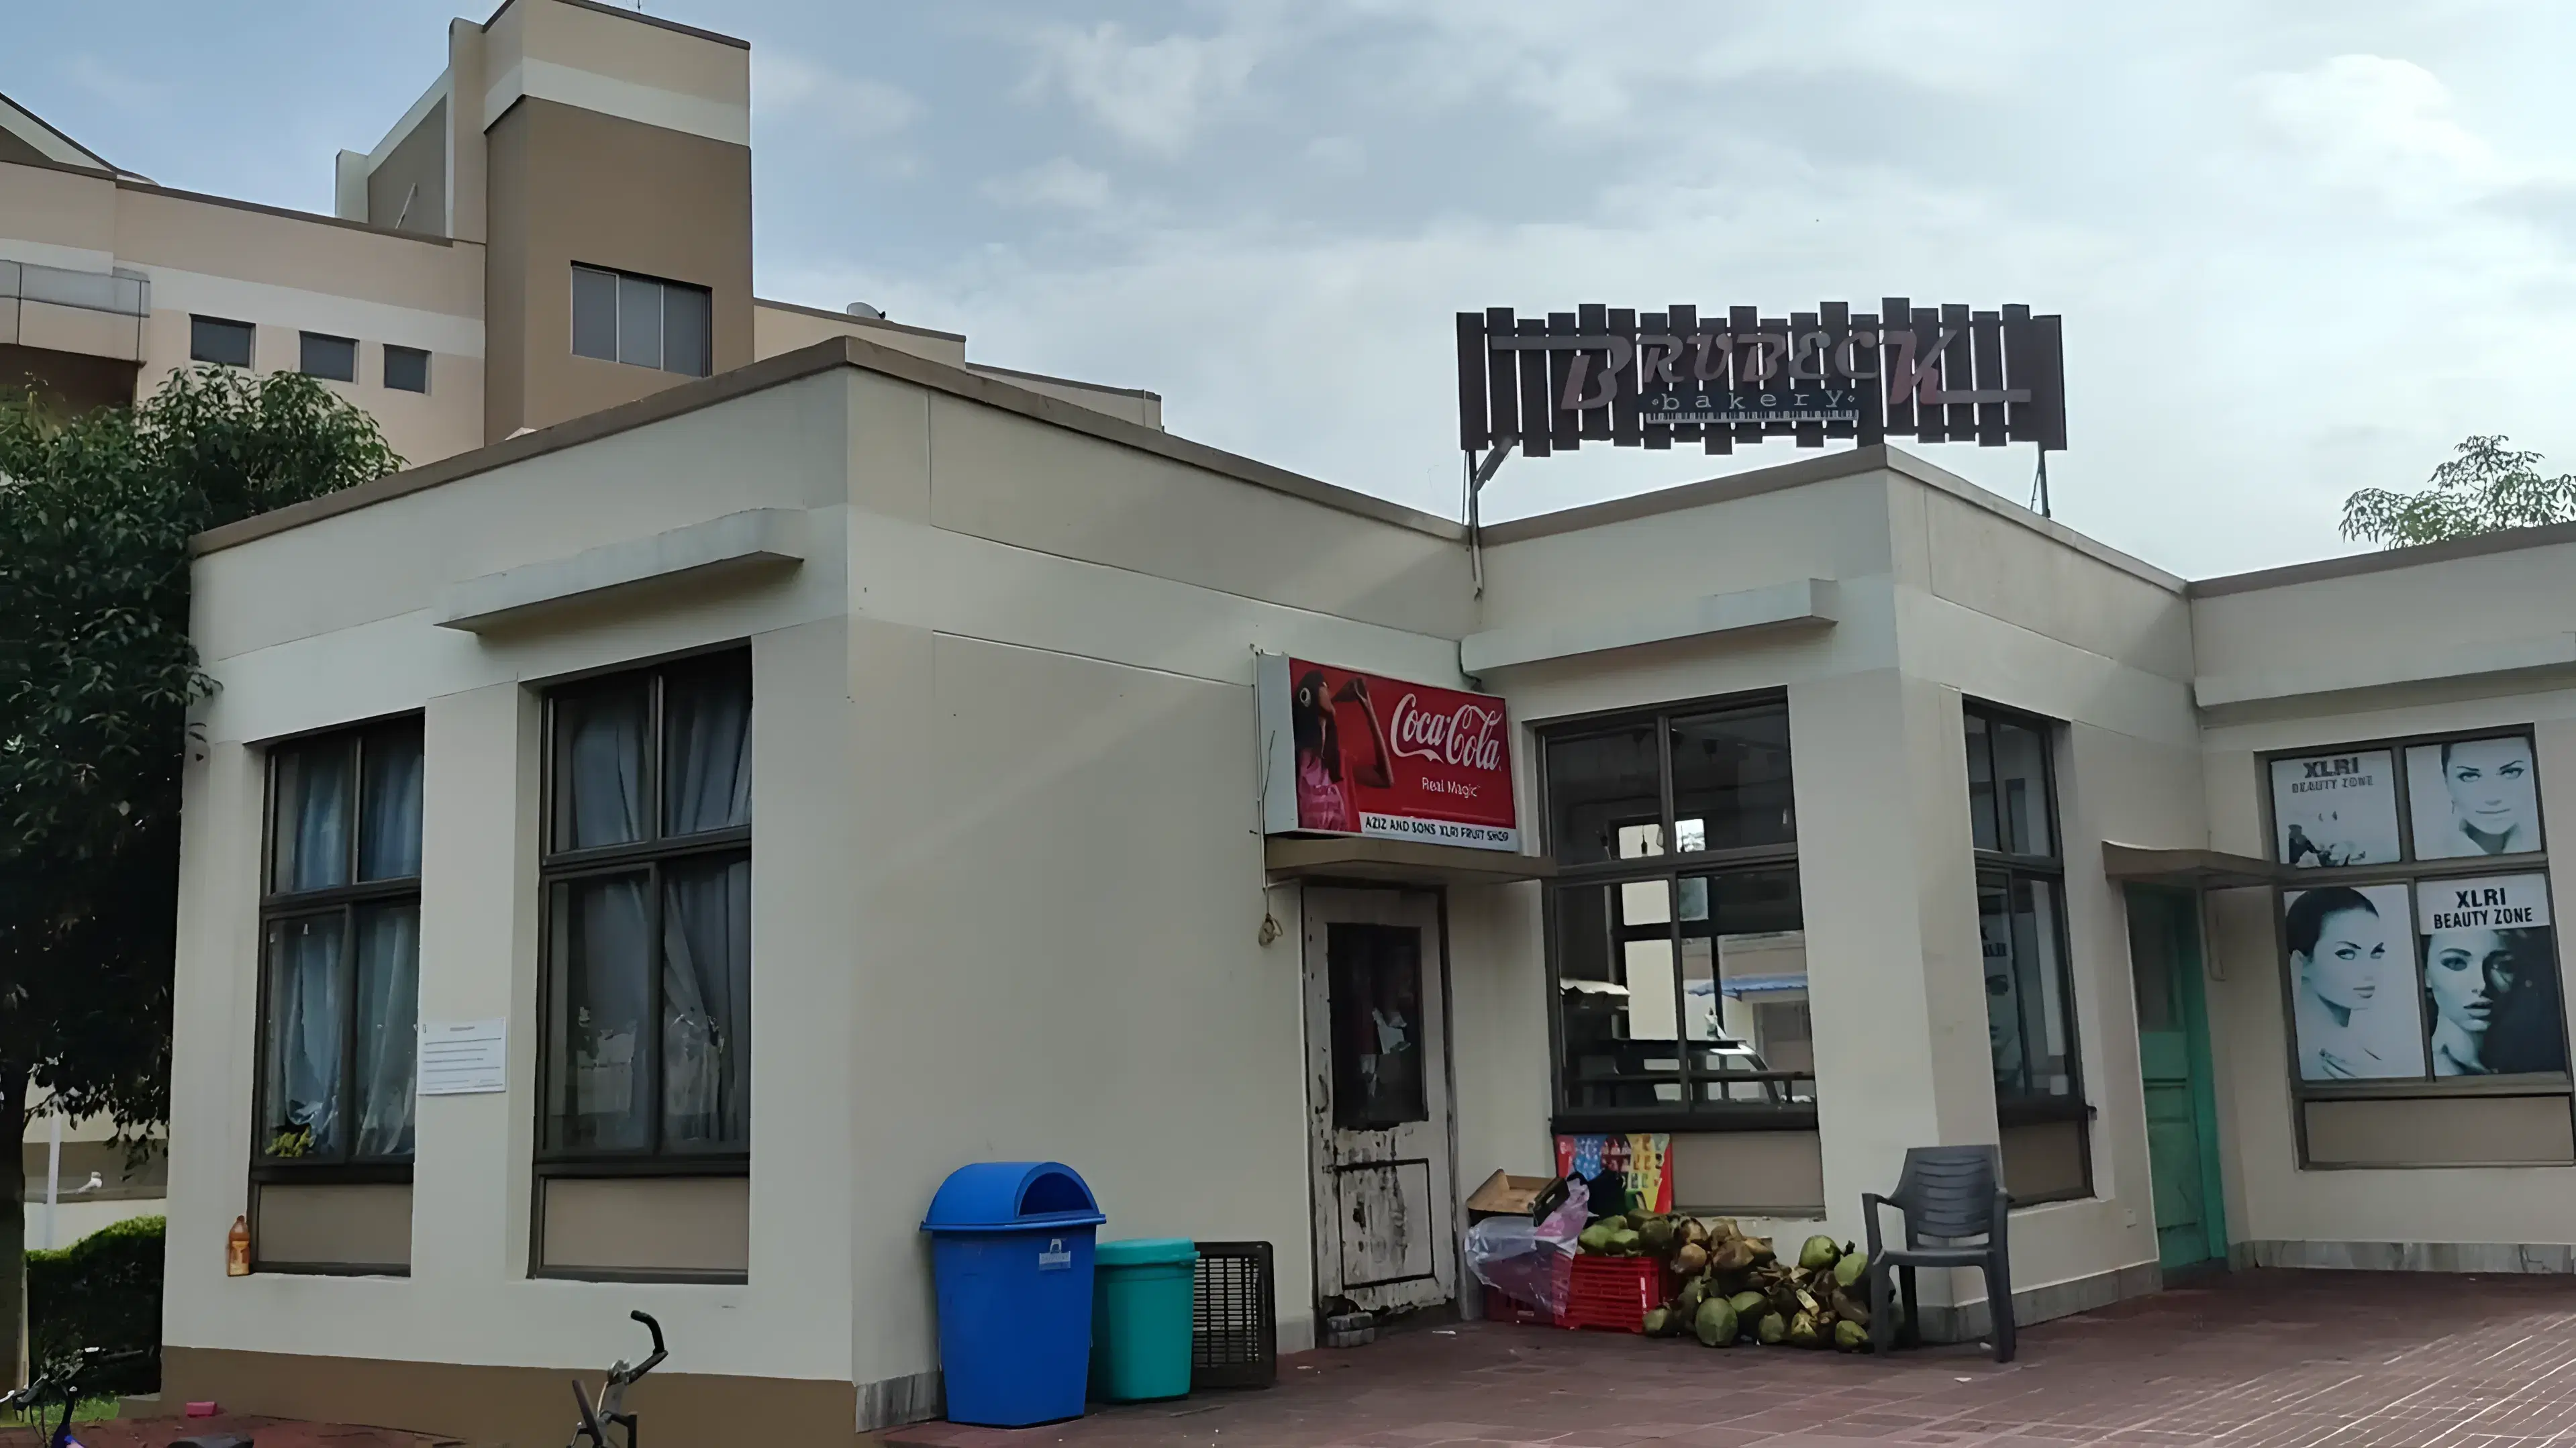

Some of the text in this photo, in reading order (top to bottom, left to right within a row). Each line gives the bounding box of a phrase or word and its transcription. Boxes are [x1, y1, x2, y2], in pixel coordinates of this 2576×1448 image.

[1491, 329, 2032, 411] BRUBECK
[1661, 389, 1844, 411] bakery
[1391, 693, 1502, 770] Coca-Cola
[2303, 757, 2359, 778] XLRI
[1422, 777, 1477, 798] Real Magic
[2291, 775, 2374, 793] BEAUTY ZONE
[1365, 816, 1387, 830] AZIZ
[1390, 819, 1409, 832] AND
[1412, 821, 1436, 835] SONS
[1440, 825, 1458, 837] XLRI
[1461, 827, 1484, 840] FRUIT
[2455, 888, 2506, 909] XLRI
[2434, 907, 2533, 929] BEAUTY ZONE
